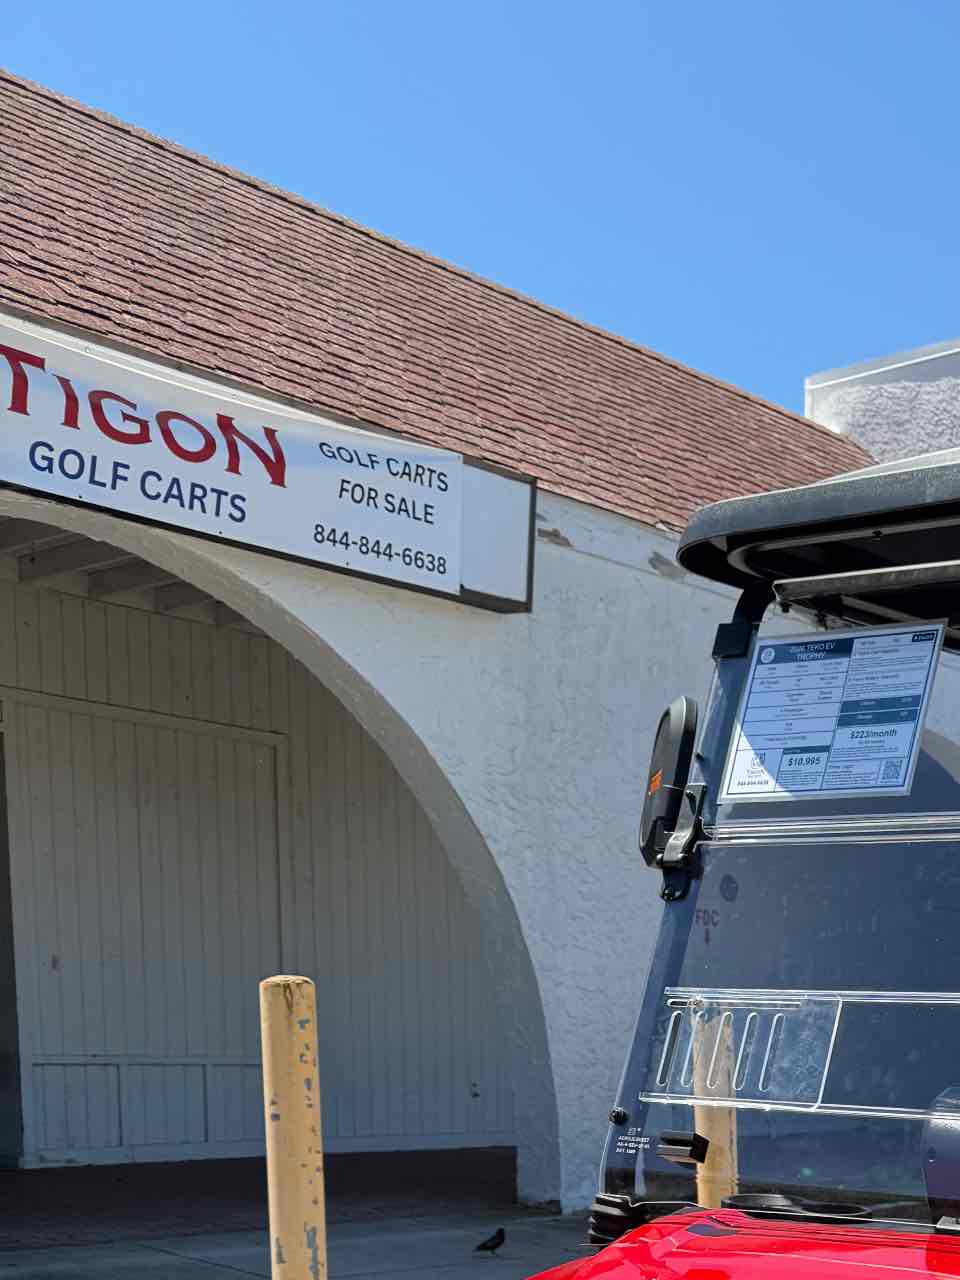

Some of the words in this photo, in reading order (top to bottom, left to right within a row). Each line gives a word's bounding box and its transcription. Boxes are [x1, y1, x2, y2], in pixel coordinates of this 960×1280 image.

[0, 345, 287, 489] TIGON
[28, 440, 130, 491] GOLF
[139, 469, 247, 523] CARTS
[318, 441, 381, 471] GOLF
[386, 457, 449, 493] CARTS
[338, 479, 378, 510] FOR
[384, 493, 435, 524] SALE
[313, 524, 447, 576] 844-844-6638
